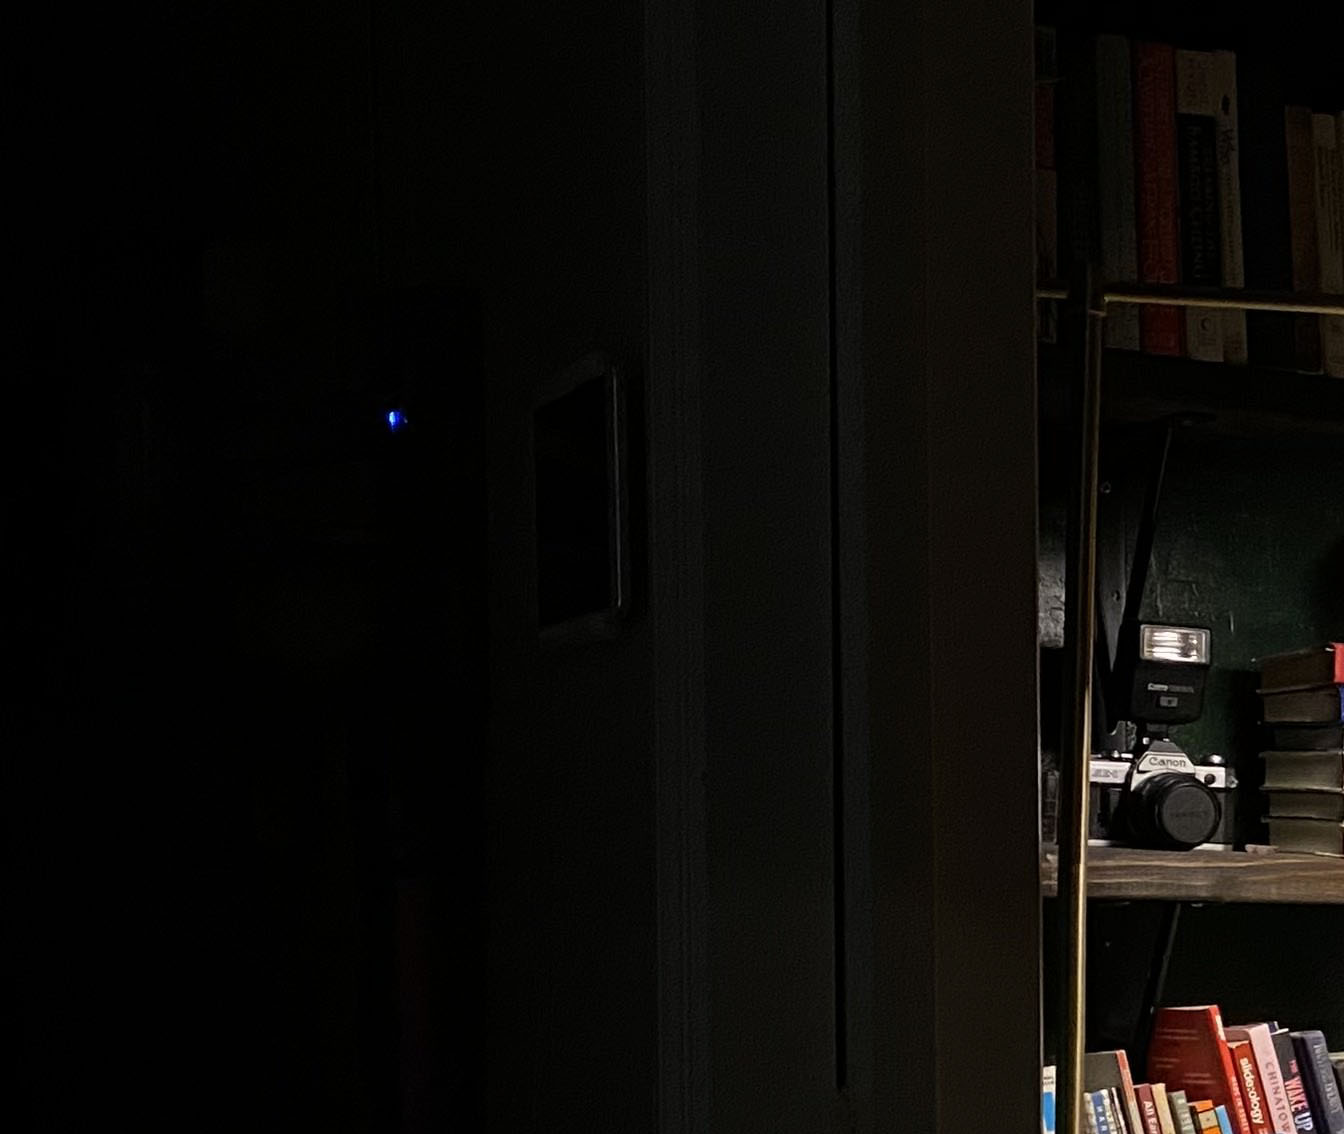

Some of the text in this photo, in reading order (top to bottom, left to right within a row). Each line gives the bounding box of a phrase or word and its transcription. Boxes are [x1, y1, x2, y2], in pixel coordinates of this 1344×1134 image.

[1149, 757, 1186, 767] Canon
[1285, 1075, 1310, 1112] WAKE
[1294, 1111, 1314, 1131] UP
